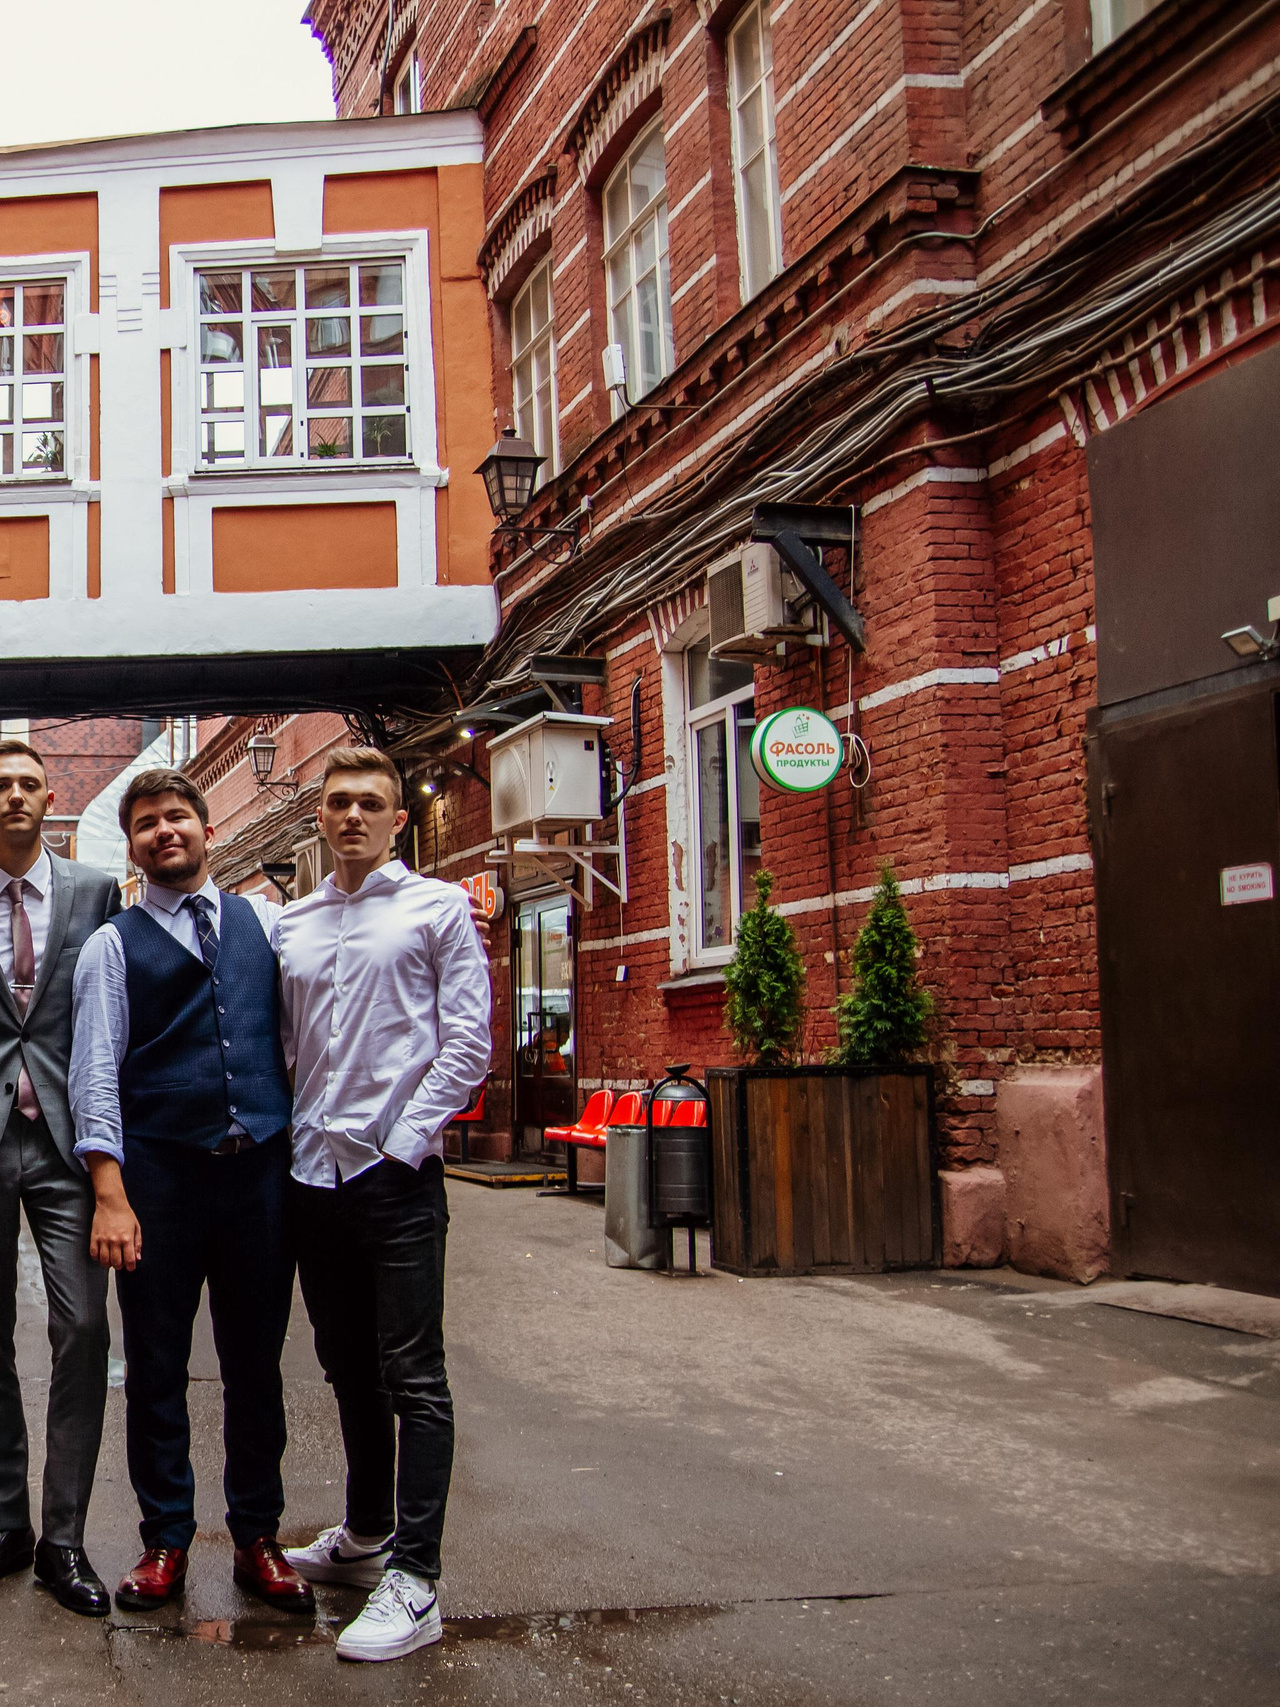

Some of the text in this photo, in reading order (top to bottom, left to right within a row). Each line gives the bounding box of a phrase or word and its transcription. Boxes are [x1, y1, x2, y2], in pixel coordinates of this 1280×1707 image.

[769, 741, 835, 757] ФАСОЛЬ
[776, 759, 830, 768] ПРОДУКТЫ
[1229, 872, 1263, 882] НЕ КУРИТЬ
[1226, 882, 1266, 894] NO SMOKING
